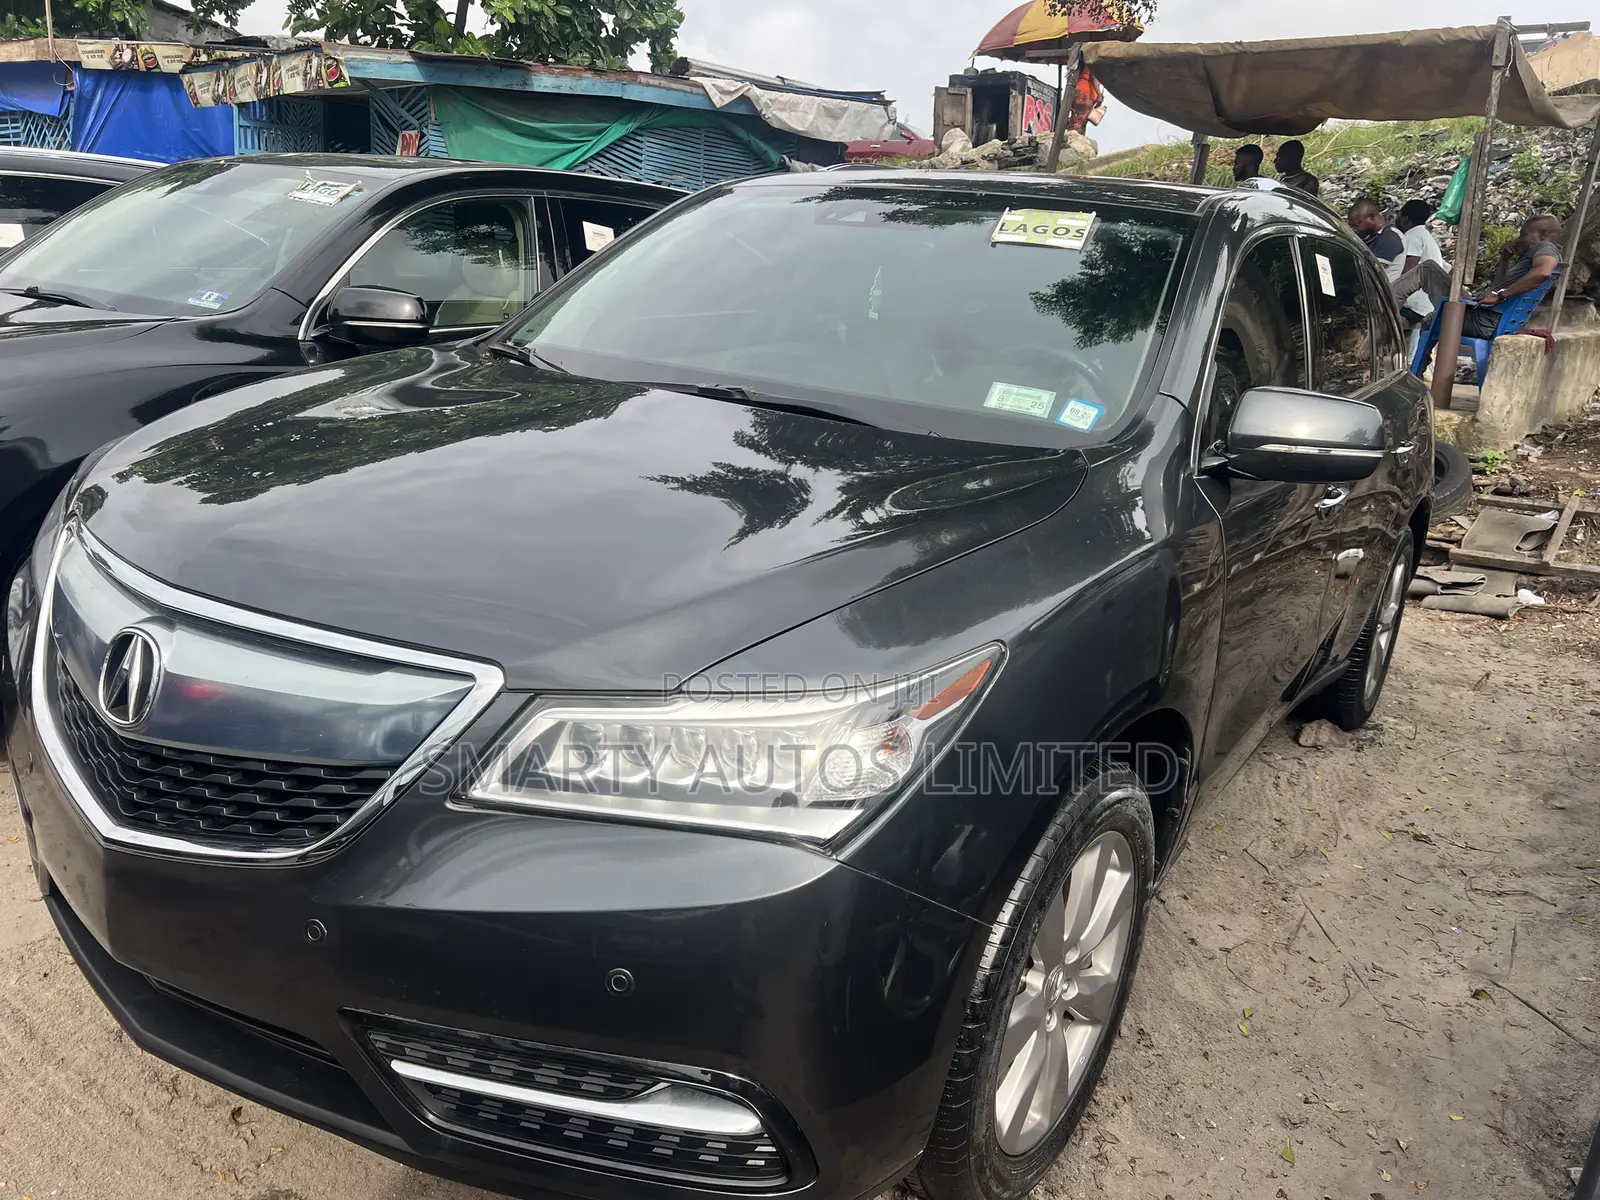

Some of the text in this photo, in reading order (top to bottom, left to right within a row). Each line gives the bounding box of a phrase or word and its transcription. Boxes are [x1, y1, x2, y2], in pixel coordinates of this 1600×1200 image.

[1023, 95, 1053, 135] POS
[300, 183, 341, 196] LAGO
[999, 222, 1086, 238] LAGOS
[1030, 401, 1045, 410] 25
